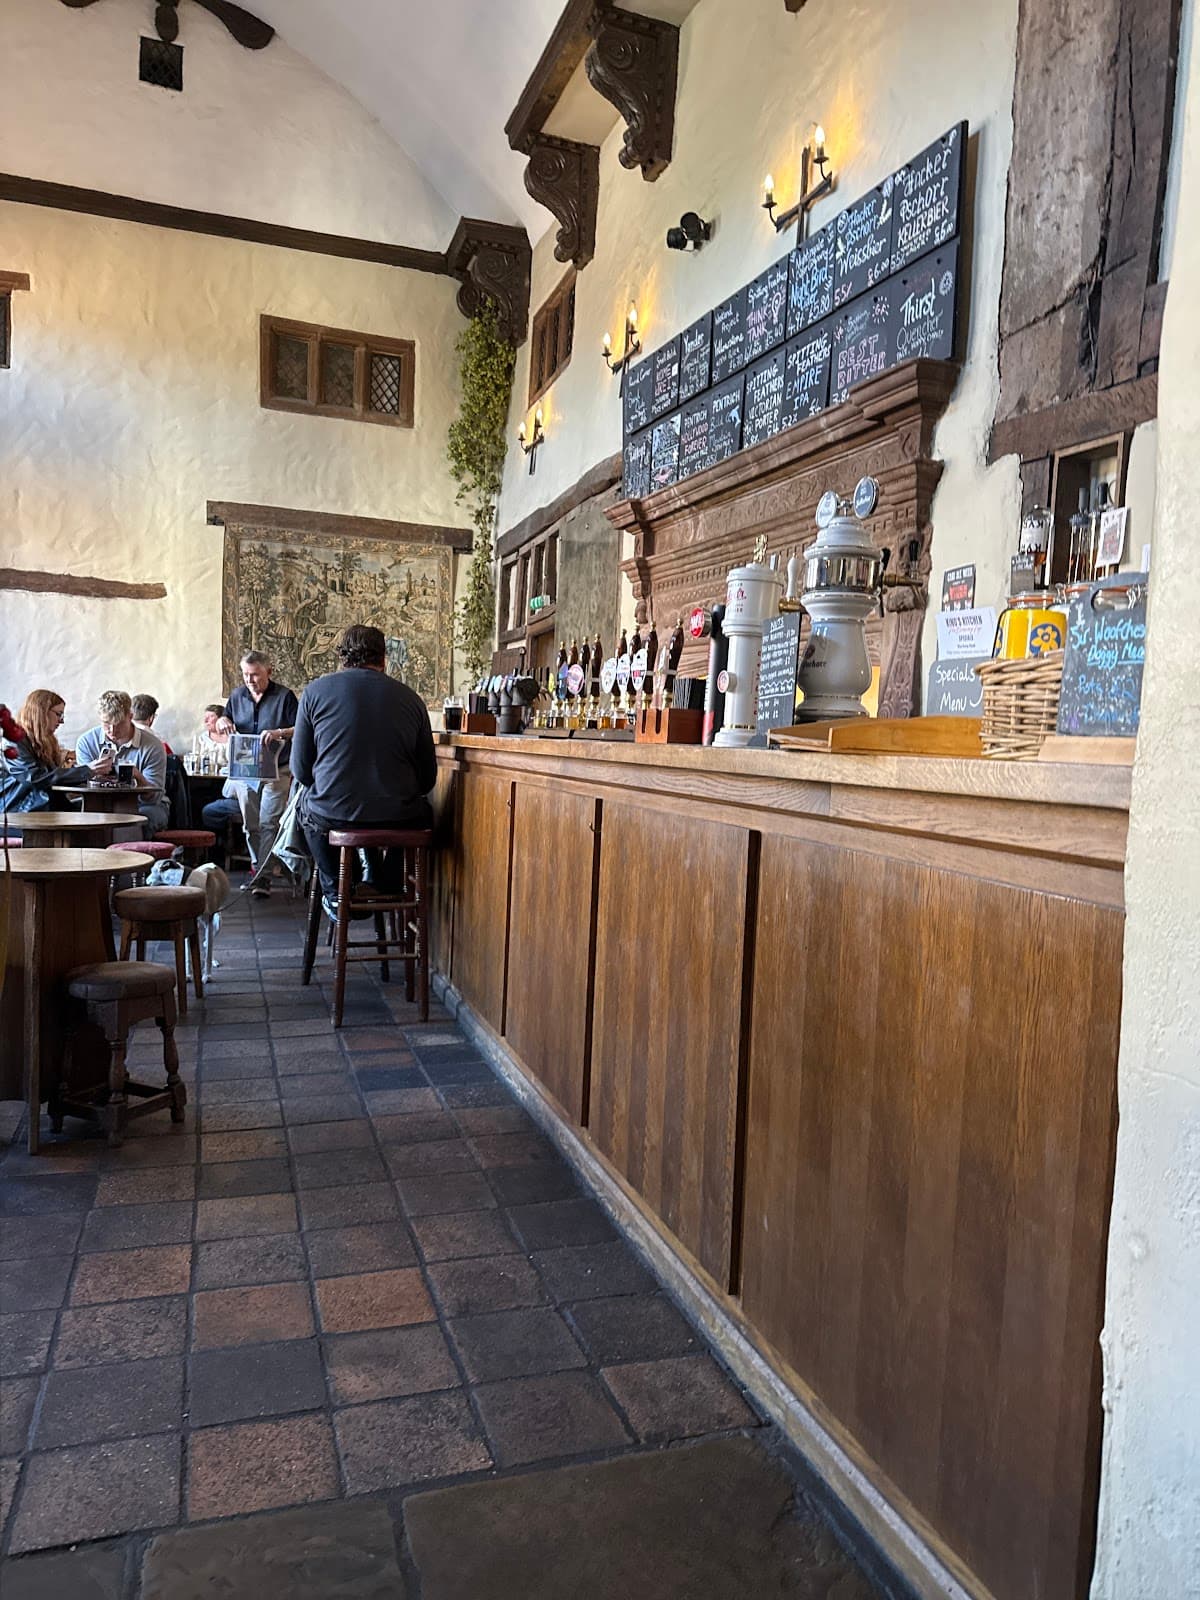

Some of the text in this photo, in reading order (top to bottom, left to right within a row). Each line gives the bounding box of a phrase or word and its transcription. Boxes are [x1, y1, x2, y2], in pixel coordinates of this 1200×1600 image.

[903, 148, 952, 197] Hacker
[900, 176, 949, 223] Pschorr
[897, 195, 949, 249] KELLERBIER
[838, 234, 887, 278] Weissbier
[900, 277, 936, 327] Thirst
[747, 321, 768, 343] TANK
[896, 309, 944, 350] Quencher
[787, 332, 829, 369] SPITTING
[796, 344, 832, 376] FEATHERS
[838, 334, 880, 369] BEST
[746, 363, 779, 395] SPITTING
[786, 364, 823, 401] EMPIRE
[837, 351, 886, 390] BITTER
[753, 374, 785, 404] FEATHERS
[793, 391, 809, 411] IPA
[748, 392, 783, 420] VICTORIAN
[754, 408, 779, 433] PORTER
[1087, 645, 1119, 671] Doggy
[935, 662, 976, 688] Specials
[939, 691, 968, 712] Menu
